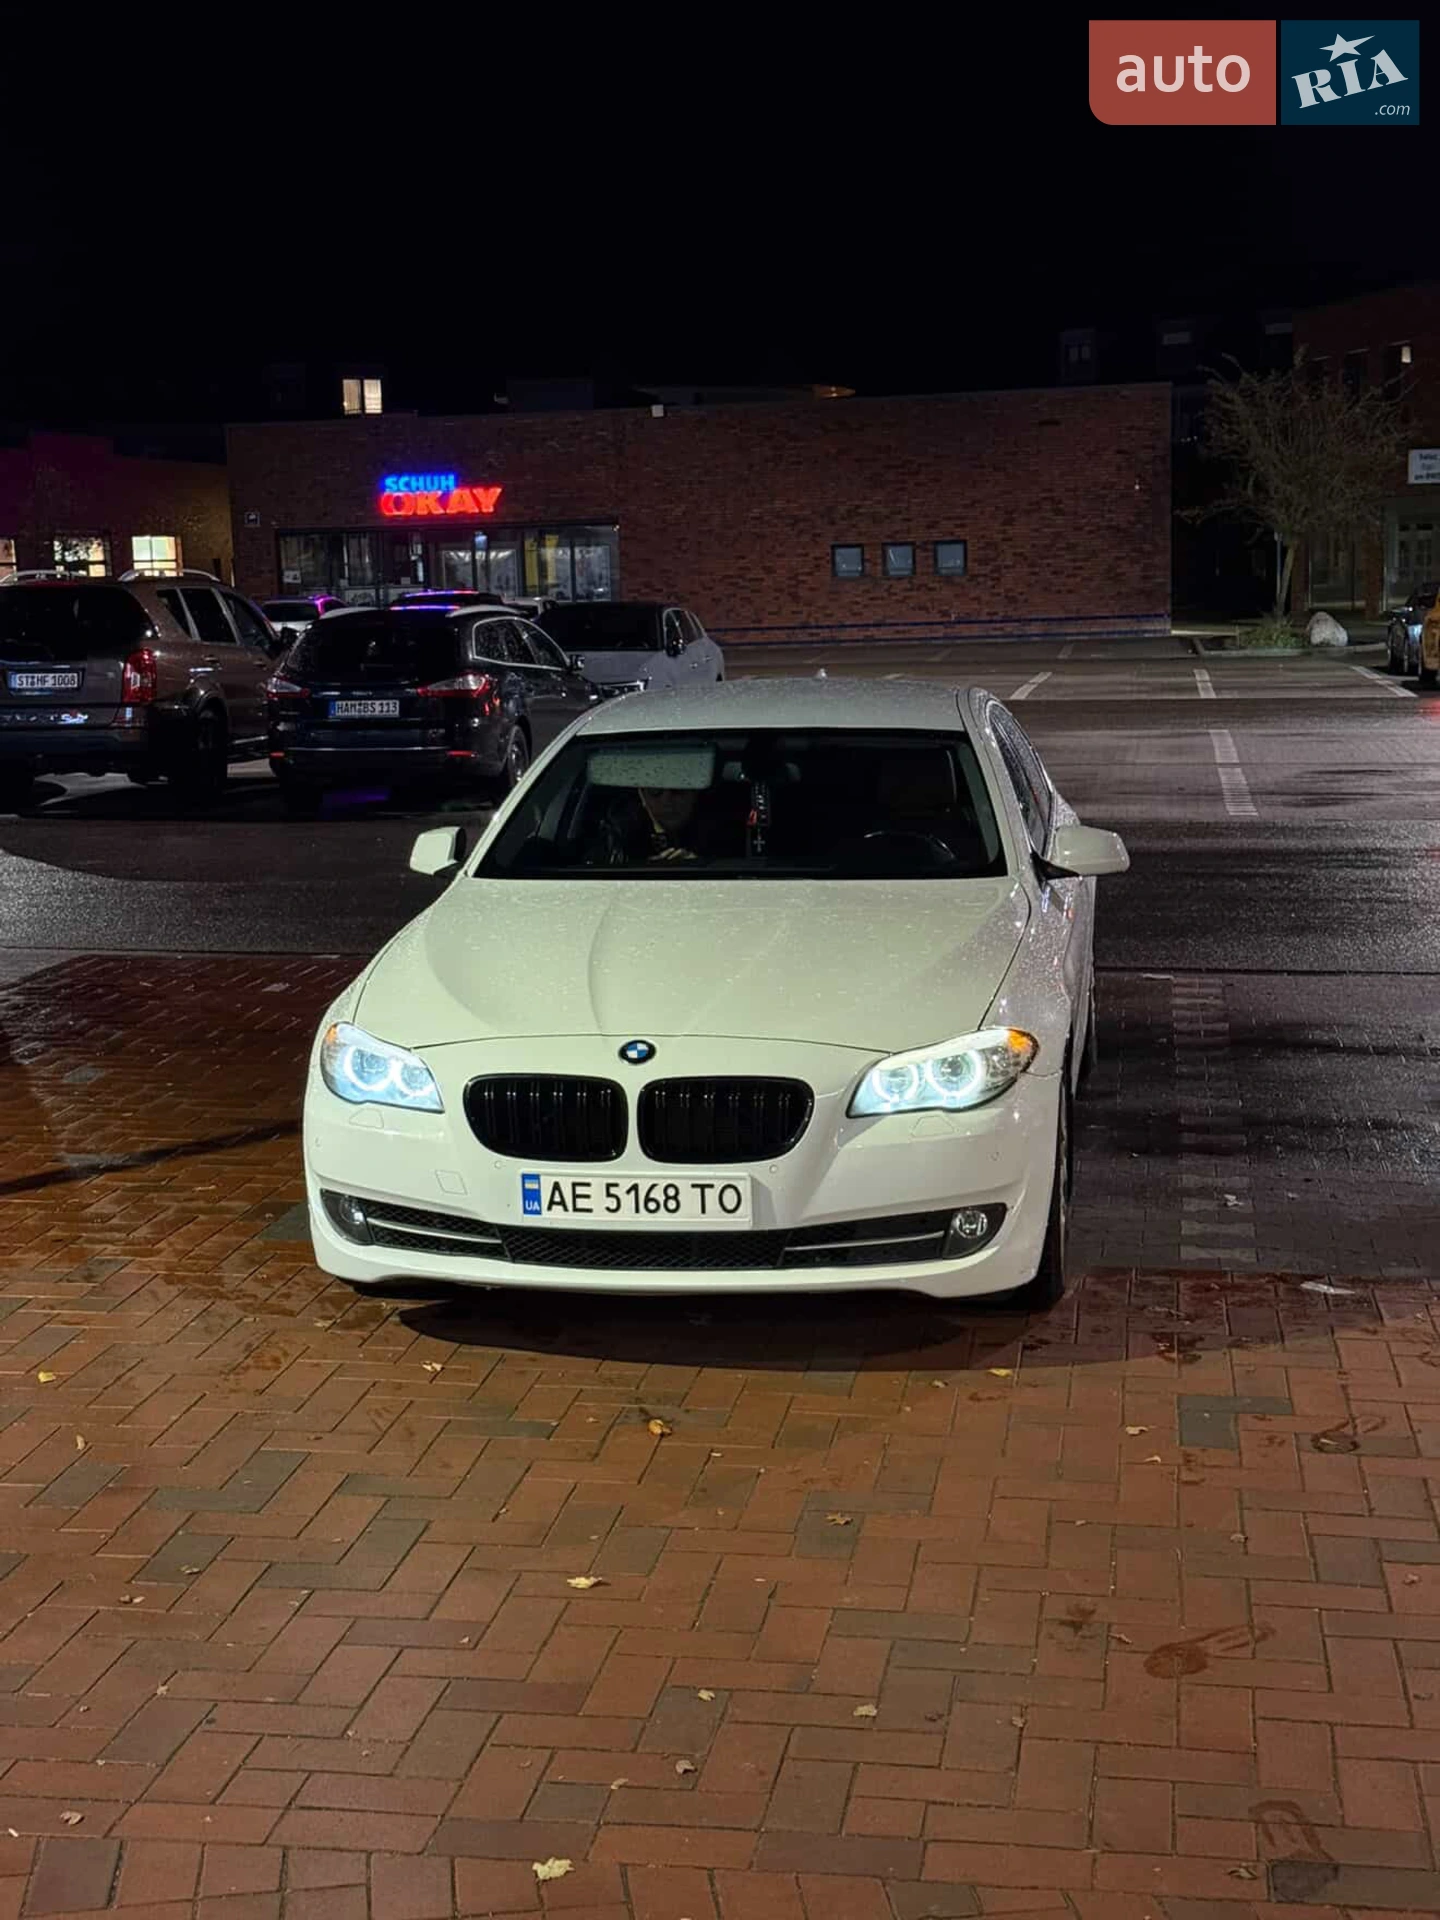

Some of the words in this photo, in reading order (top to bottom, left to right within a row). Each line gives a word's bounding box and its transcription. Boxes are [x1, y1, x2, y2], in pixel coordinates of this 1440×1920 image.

[385, 475, 455, 492] SCHUH
[381, 487, 502, 515] OKAY
[51, 675, 76, 686] 1008
[379, 702, 397, 713] 113
[547, 1181, 593, 1213] AE
[605, 1183, 680, 1214] 5168
[691, 1184, 742, 1214] TO
[525, 1200, 541, 1211] UA
